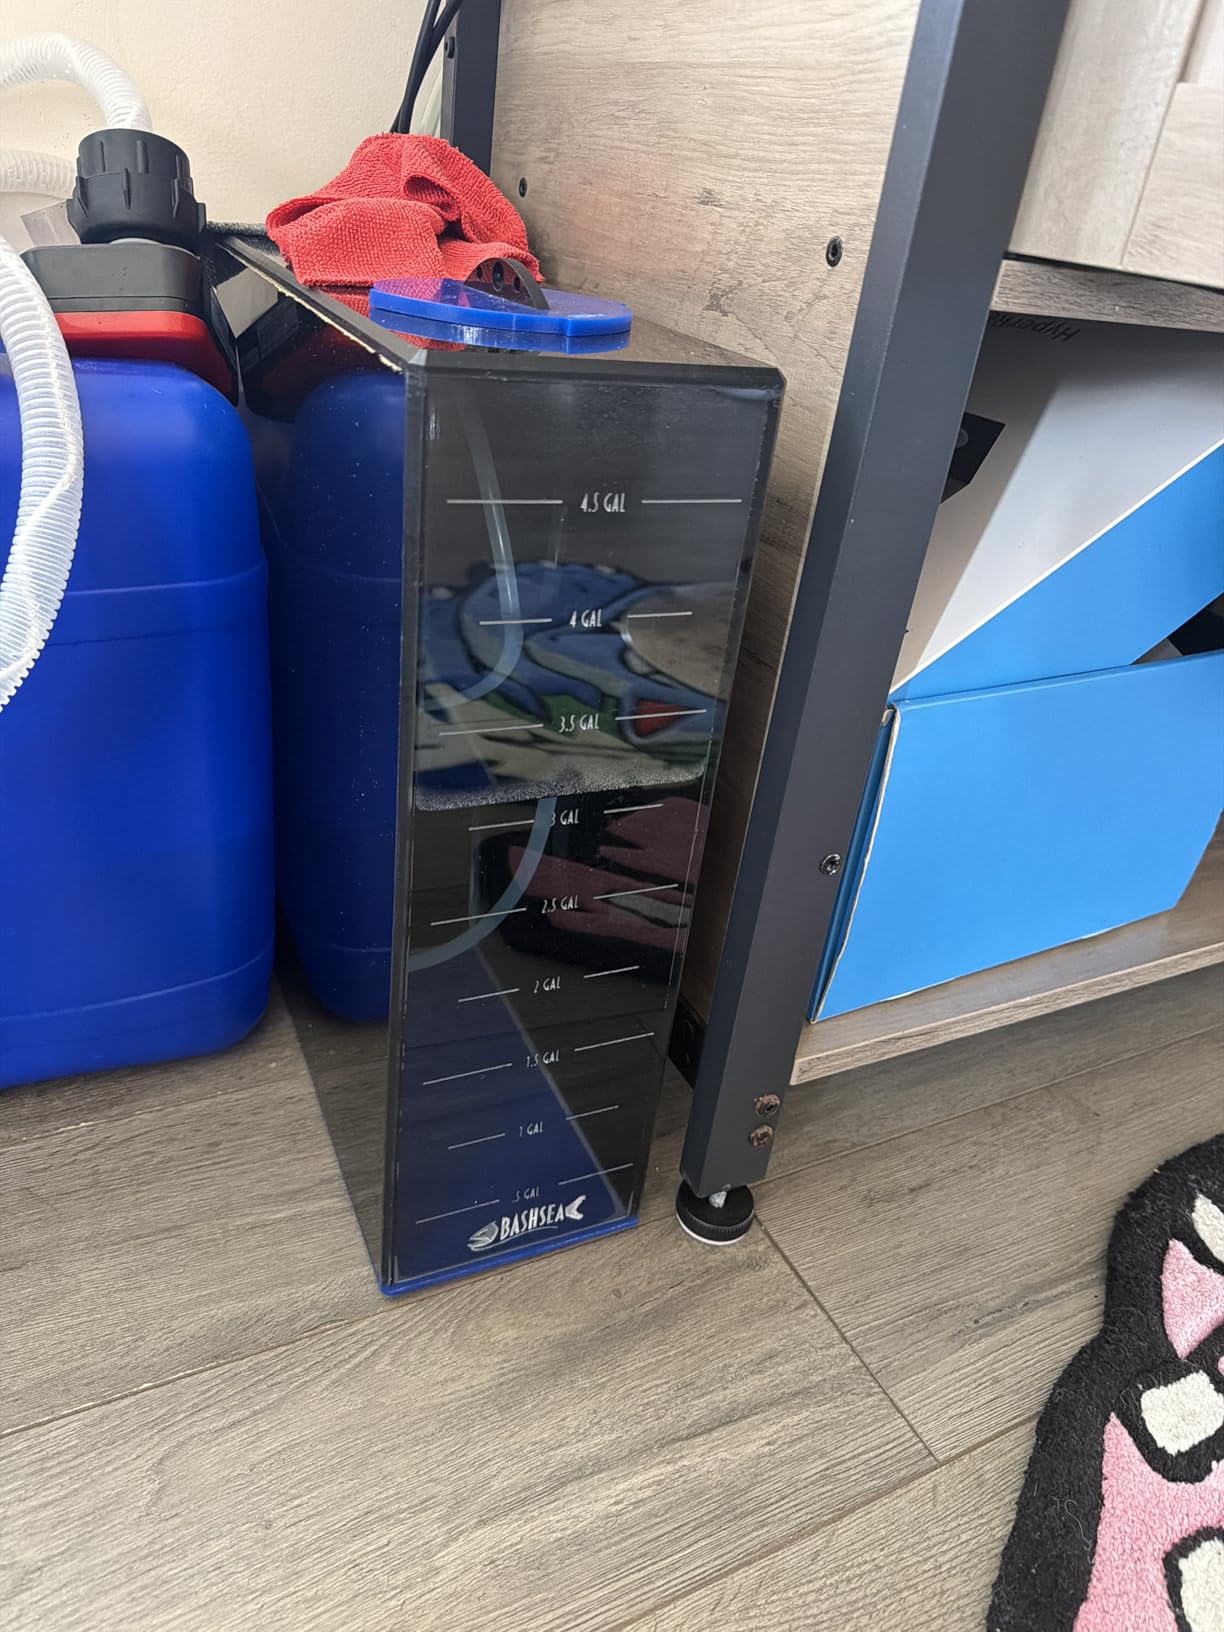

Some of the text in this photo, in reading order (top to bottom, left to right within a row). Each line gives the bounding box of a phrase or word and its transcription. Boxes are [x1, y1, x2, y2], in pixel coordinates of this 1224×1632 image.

[579, 492, 626, 513] 4.5 GAL
[569, 609, 603, 628] 4 GAL
[558, 712, 600, 733] 3.5 GAL
[560, 808, 580, 825] GAL
[541, 895, 579, 914] 2.5 GAL
[533, 976, 561, 994] 2 GAL
[525, 1049, 561, 1068] 1.5 GAL
[519, 1121, 544, 1137] 1 GAL
[523, 1186, 540, 1201] GAL
[500, 1203, 565, 1240] BASHSEA
